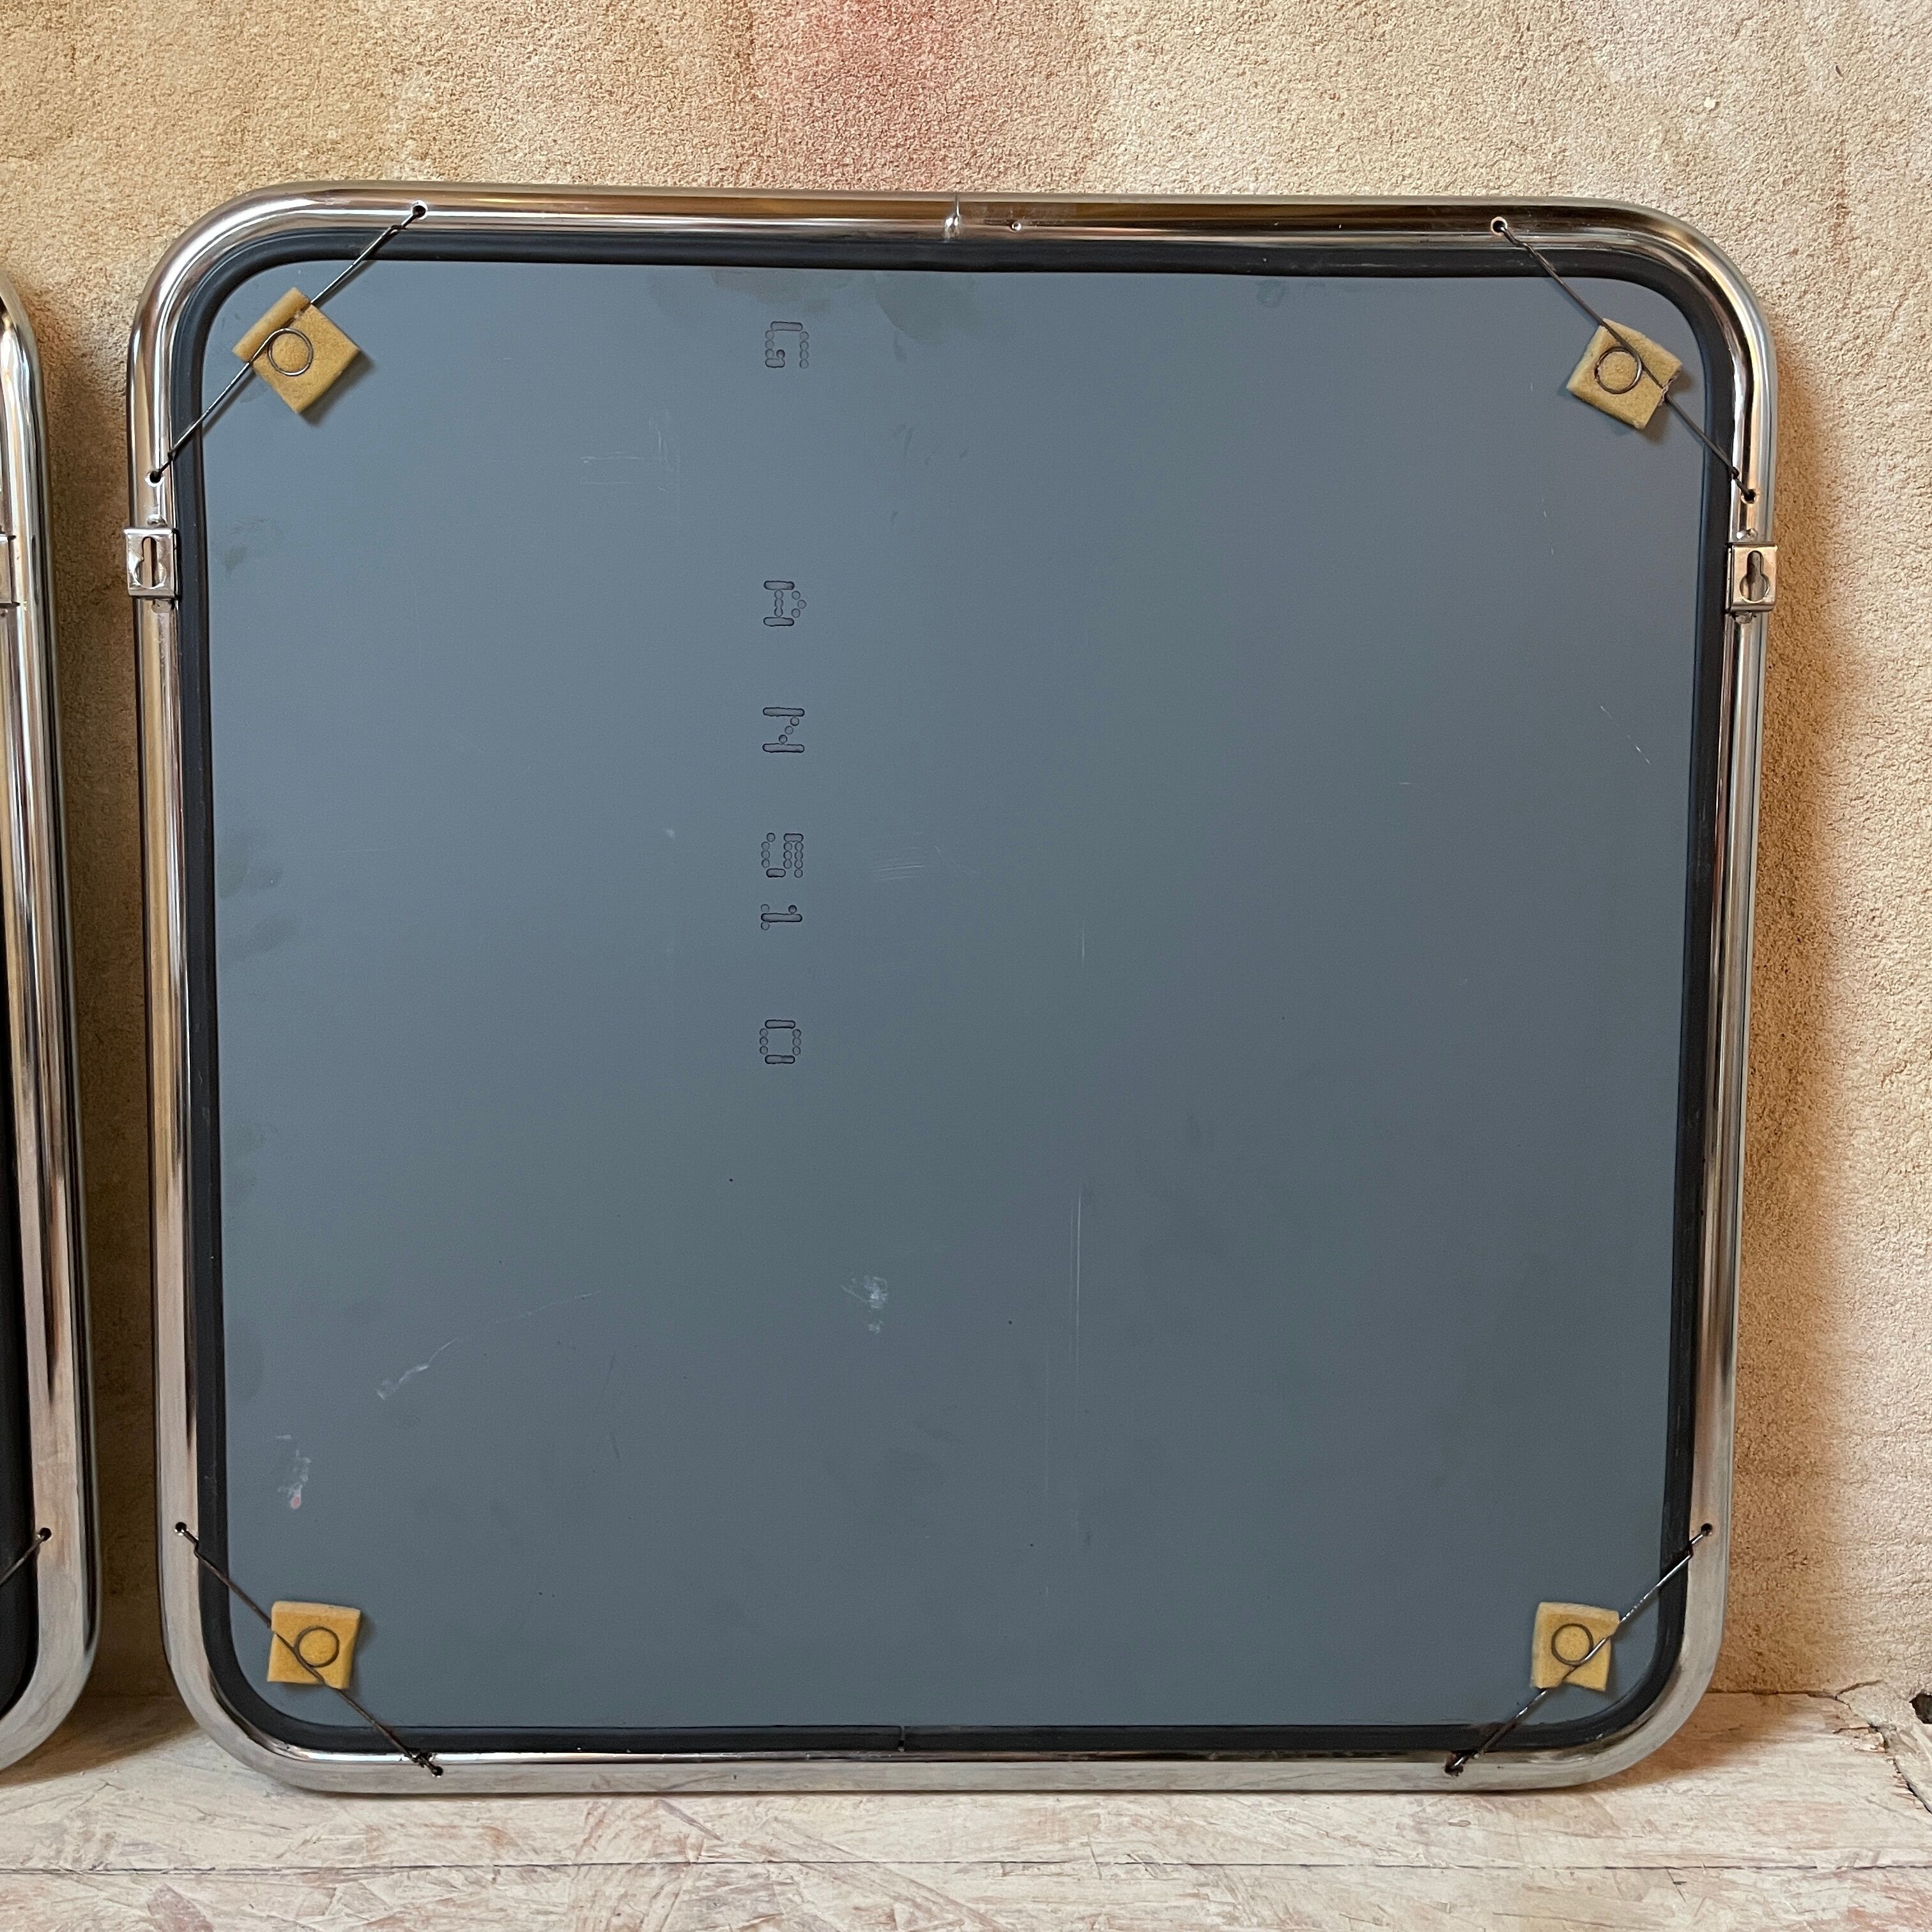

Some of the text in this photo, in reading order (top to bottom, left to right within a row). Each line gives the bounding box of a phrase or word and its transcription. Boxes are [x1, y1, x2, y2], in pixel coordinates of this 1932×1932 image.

[764, 321, 809, 369] G
[762, 579, 807, 627] A
[762, 705, 806, 754] N
